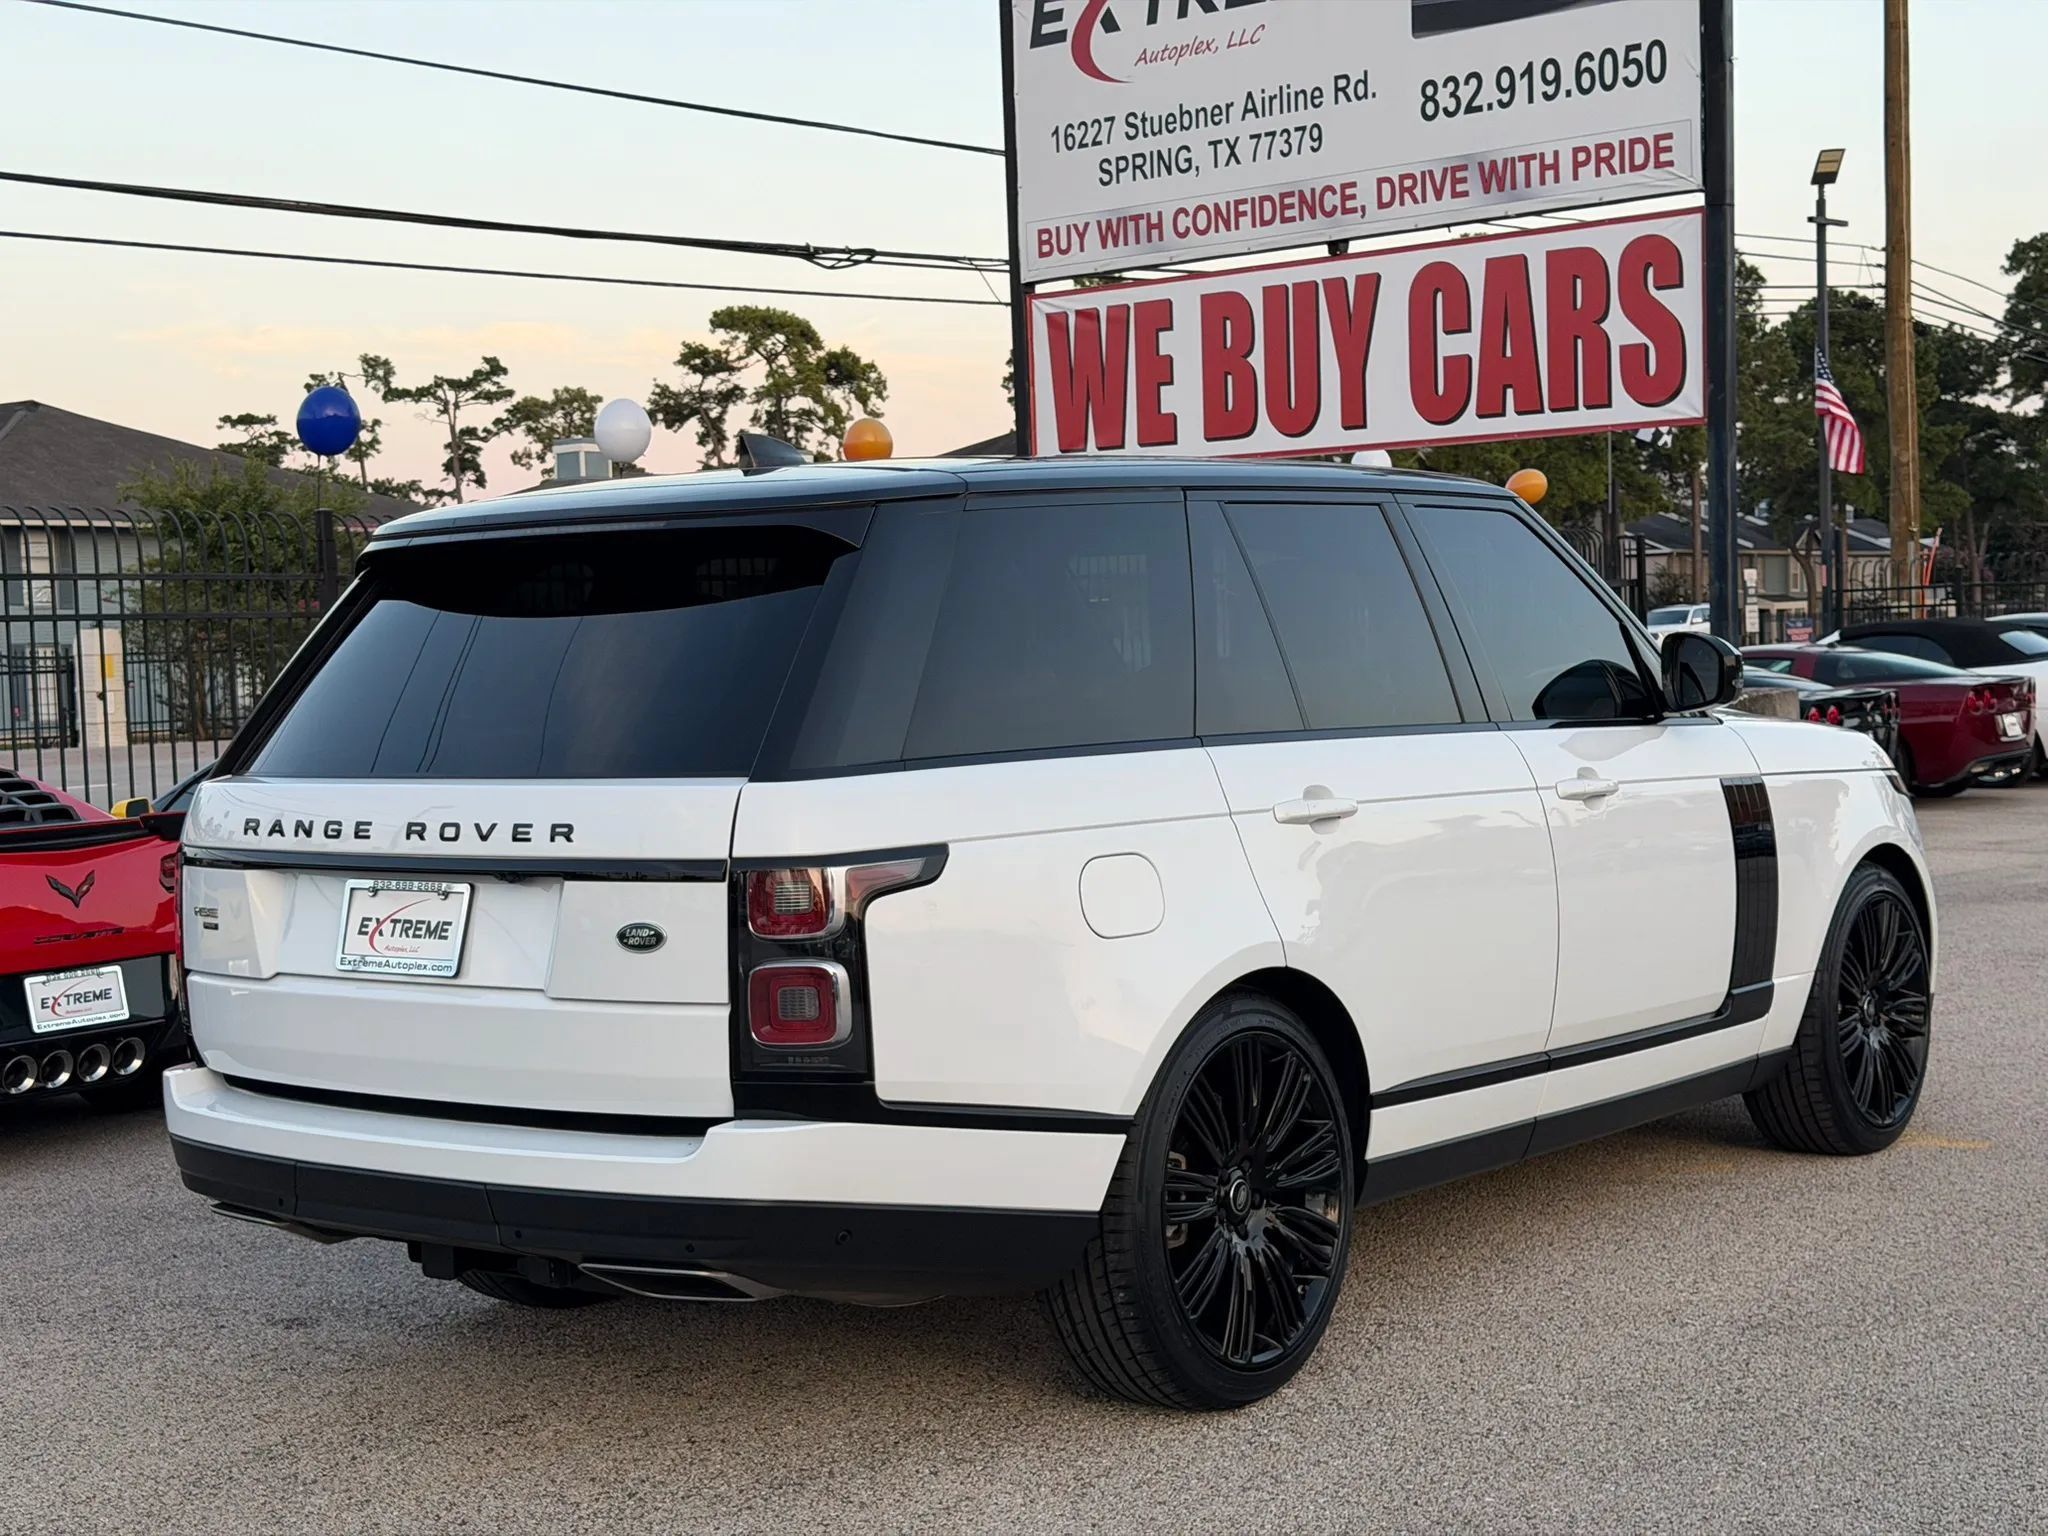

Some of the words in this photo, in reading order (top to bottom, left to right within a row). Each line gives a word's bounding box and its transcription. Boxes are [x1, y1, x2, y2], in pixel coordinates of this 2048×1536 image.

[1135, 35, 1218, 66] Autoplex,
[1226, 24, 1266, 49] LLC
[1420, 39, 1667, 122] 832.919.6050
[1050, 115, 1116, 154] 16227
[1124, 101, 1235, 141] Stuebner
[1240, 83, 1324, 122] Airline
[1333, 69, 1377, 105] Rd.
[1098, 144, 1200, 187] SPRING,
[1207, 136, 1242, 169] TX
[1248, 123, 1323, 162] 77379
[1037, 222, 1089, 259] BUY
[1097, 211, 1164, 249] WITH
[1172, 182, 1366, 239] CONFIDENCE,
[1376, 164, 1468, 209] DRIVE
[1477, 150, 1561, 193] WITH
[1571, 133, 1674, 181] PRIDE
[1046, 298, 1178, 454] WE
[1200, 272, 1382, 443] BUY
[1408, 234, 1687, 425] CARS
[243, 817, 373, 840] RANGE
[405, 821, 575, 843] ROVER
[357, 916, 453, 941] EXTREME
[626, 928, 649, 937] LAND
[628, 937, 657, 945] ROVER
[340, 957, 453, 972] ExtremeAutoplex.com
[41, 987, 113, 1009] EXTREME
